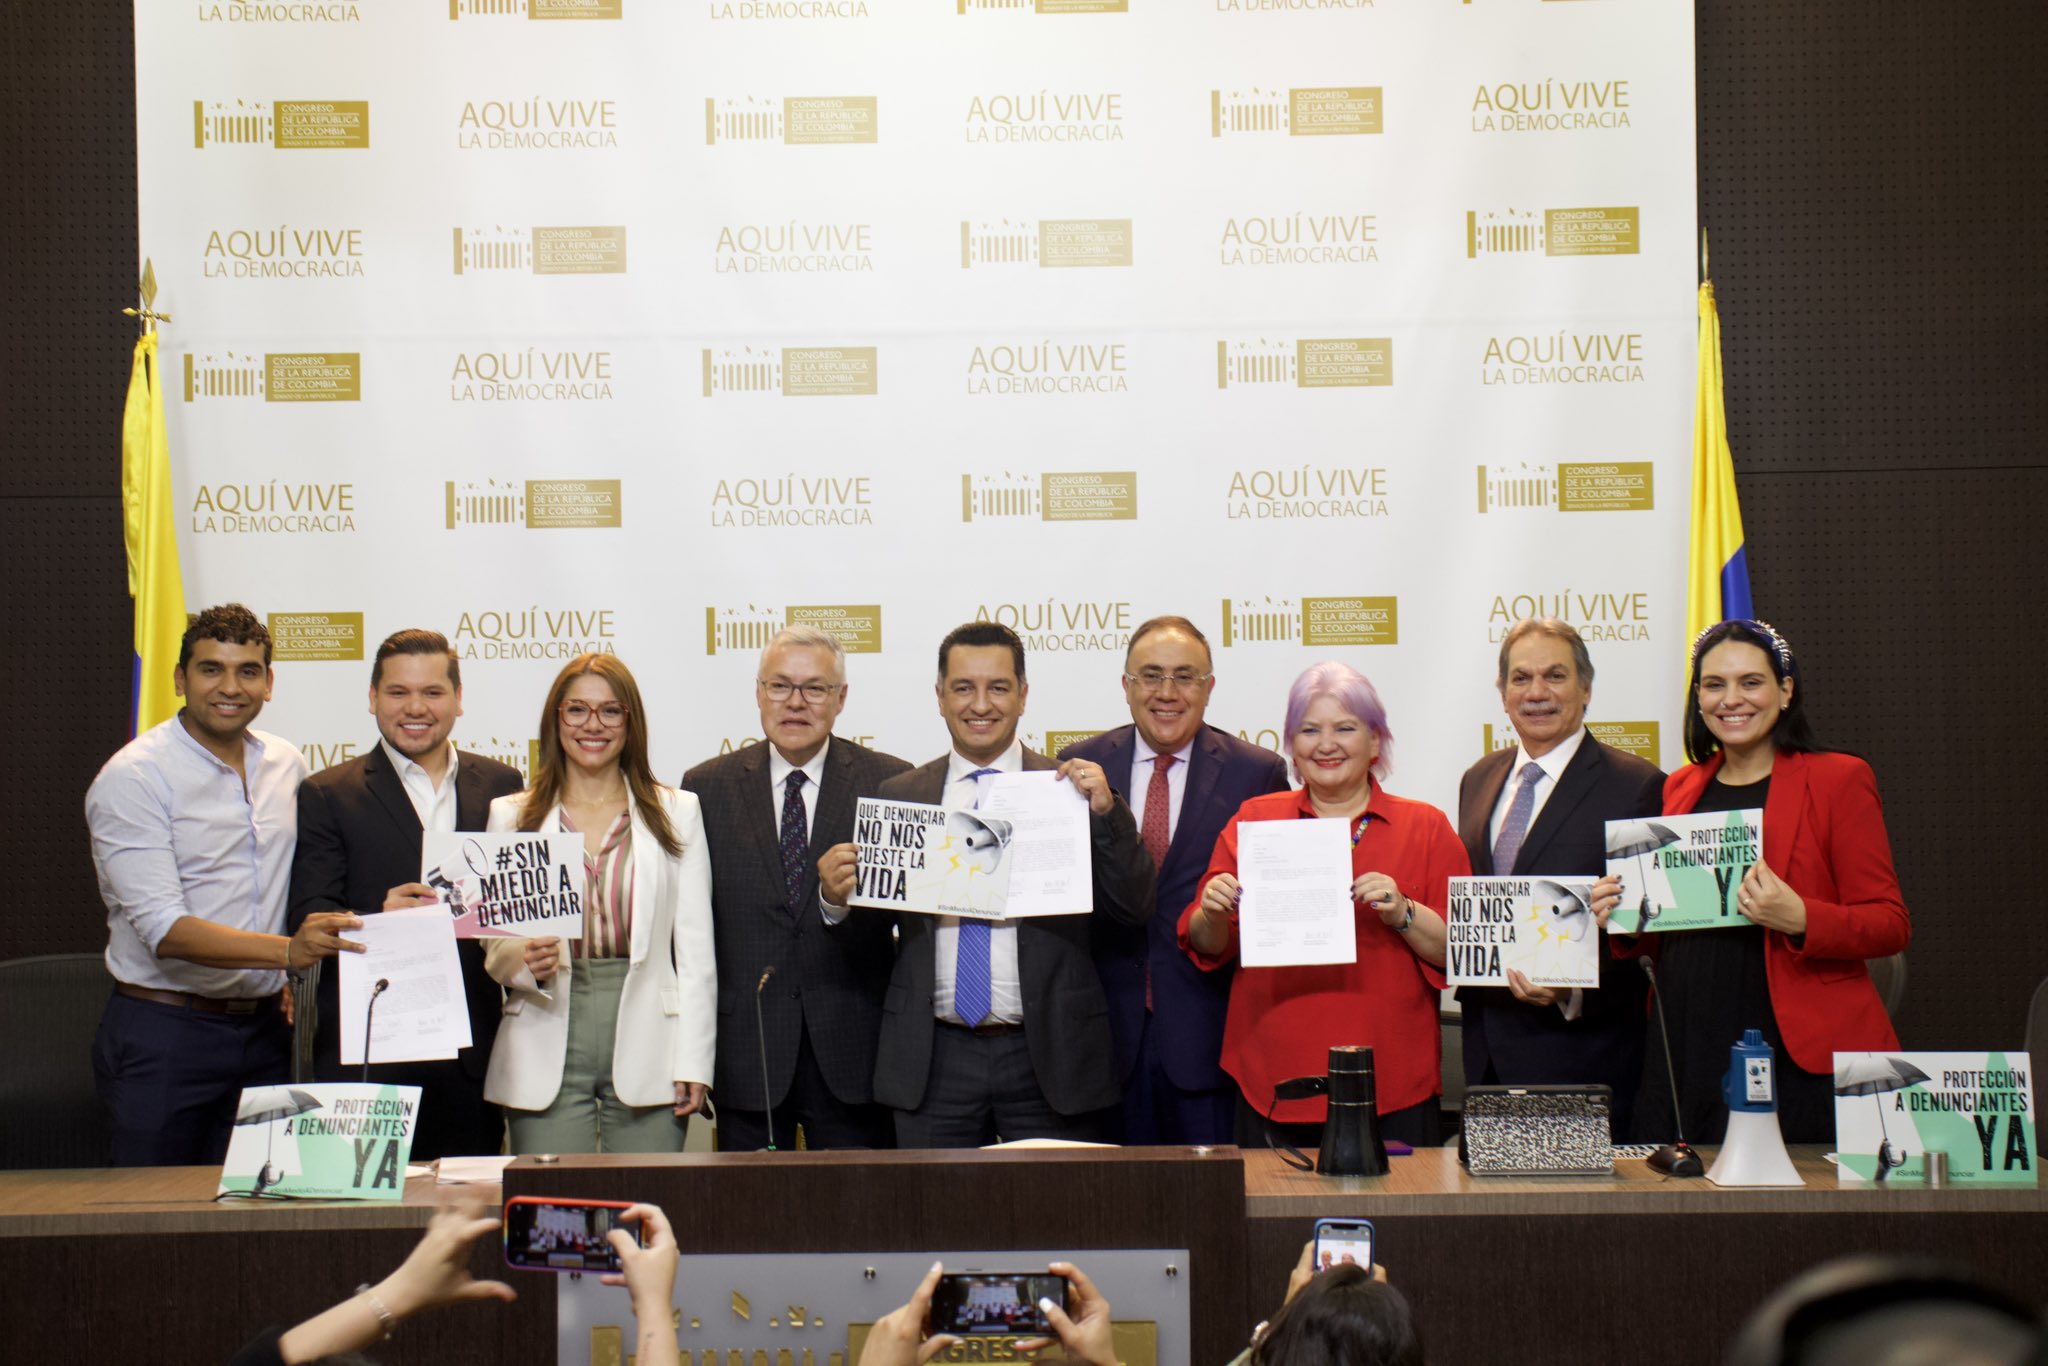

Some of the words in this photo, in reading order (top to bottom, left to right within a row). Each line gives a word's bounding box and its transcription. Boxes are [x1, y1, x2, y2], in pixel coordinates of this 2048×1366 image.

[199, 5, 223, 21] LA
[229, 4, 360, 21] DEMOCRACIA
[711, 3, 734, 19] LA
[740, 1, 869, 19] DEMOCRACIA
[1472, 77, 1554, 113] AQUÍ
[1560, 81, 1630, 110] VIVE
[282, 105, 334, 113] CONGRESO
[459, 96, 541, 131] AQUÍ
[548, 101, 616, 128] VIVE
[966, 89, 1047, 125] AQUÍ
[1054, 94, 1122, 122] VIVE
[282, 116, 294, 124] DE
[297, 116, 308, 124] LA
[1471, 115, 1496, 132] LA
[1501, 112, 1631, 132] DEMOCRACIA
[459, 132, 483, 149] LA
[489, 131, 618, 149] DEMOCRACIA
[966, 126, 990, 143] LA
[996, 124, 1123, 143] DEMOCRACIA
[716, 220, 796, 255] AQUÍ
[803, 224, 871, 252] VIVE
[1221, 211, 1302, 247] AQUÍ
[1309, 215, 1377, 244] VIVE
[205, 225, 287, 260] AQUÍ
[294, 230, 363, 257] VIVE
[715, 256, 739, 273] LA
[745, 255, 873, 273] DEMOCRACIA
[1220, 248, 1244, 265] LA
[1250, 246, 1378, 265] DEMOCRACIA
[204, 261, 228, 277] LA
[235, 260, 364, 277] DEMOCRACIA
[1304, 342, 1357, 351] CONGRESO
[1482, 330, 1565, 366] AQUÍ
[1572, 334, 1642, 363] VIVE
[273, 357, 326, 366] CONGRESO
[452, 347, 535, 383] AQUÍ
[542, 352, 611, 380] VIVE
[968, 339, 1050, 375] AQUÍ
[1057, 344, 1126, 373] VIVE
[1320, 354, 1331, 362] LA
[1482, 368, 1506, 385] LA
[1513, 365, 1644, 384] DEMOCRACIA
[452, 384, 476, 401] LA
[482, 383, 612, 401] DEMOCRACIA
[967, 377, 991, 394] LA
[998, 376, 1128, 394] DEMOCRACIA
[1565, 466, 1618, 475] CONGRESO
[533, 483, 587, 492] CONGRESO
[1049, 476, 1102, 485] CONGRESO
[1227, 464, 1310, 500] AQUÍ
[1317, 468, 1386, 497] VIVE
[1580, 478, 1592, 486] LA
[193, 479, 278, 514] AQUÍ
[285, 484, 354, 512] VIVE
[534, 495, 545, 503] DE
[548, 495, 560, 503] LA
[712, 473, 795, 508] AQUÍ
[802, 477, 871, 505] VIVE
[1580, 489, 1630, 498] COLOMBIA
[1064, 499, 1114, 507] COLOMBIA
[1227, 502, 1251, 519] LA
[1257, 500, 1388, 519] DEMOCRACIA
[193, 516, 217, 532] LA
[224, 515, 356, 532] DEMOCRACIA
[711, 510, 736, 527] LA
[742, 508, 872, 526] DEMOCRACIA
[1310, 600, 1362, 609] CONGRESO
[1578, 593, 1648, 621] VIVE
[276, 616, 329, 625] CONGRESO
[455, 605, 538, 641] AQUÍ
[545, 610, 615, 638] VIVE
[1061, 602, 1131, 630] VIVE
[1325, 612, 1336, 620] LA
[277, 628, 288, 636] DE
[1325, 624, 1374, 632] COLOMBIA
[1578, 624, 1650, 641] CRACIA
[277, 640, 288, 648] DE
[291, 639, 341, 647] COLOMBIA
[455, 643, 479, 659] LA
[859, 803, 880, 819] QUE
[884, 806, 946, 826] DENUNCIAR
[857, 819, 882, 845] NO
[890, 822, 926, 849] NOS
[1691, 823, 1757, 846] PROTECCIÓN
[495, 839, 550, 870] #SIN
[857, 845, 905, 867] CUESTE
[910, 851, 925, 869] LA
[1653, 852, 1660, 869] A
[1665, 844, 1758, 869] DENUNCIANTES
[479, 867, 549, 903] MIEDO
[559, 864, 572, 892] A
[855, 865, 906, 901] VIDA
[1450, 882, 1468, 897] QUE
[1472, 881, 1530, 897] DENUNCIAR
[1714, 865, 1752, 917] Y
[477, 892, 581, 927] DENUNCIAR
[1450, 897, 1472, 923] NO
[1480, 897, 1514, 923] NOS
[1450, 925, 1497, 943] CUESTE
[1502, 925, 1516, 943] LA
[1451, 945, 1502, 977] VIDA
[1943, 1068, 2026, 1089] PROTECCIÓN
[334, 1097, 413, 1116] PROTECCIÓN
[1895, 1094, 1904, 1112] A
[1911, 1092, 2028, 1112] DENUNCIANTES
[284, 1119, 293, 1135] A
[299, 1118, 409, 1136] DENUNCIANTES
[1974, 1115, 2030, 1171] YA
[352, 1138, 399, 1189] YA
